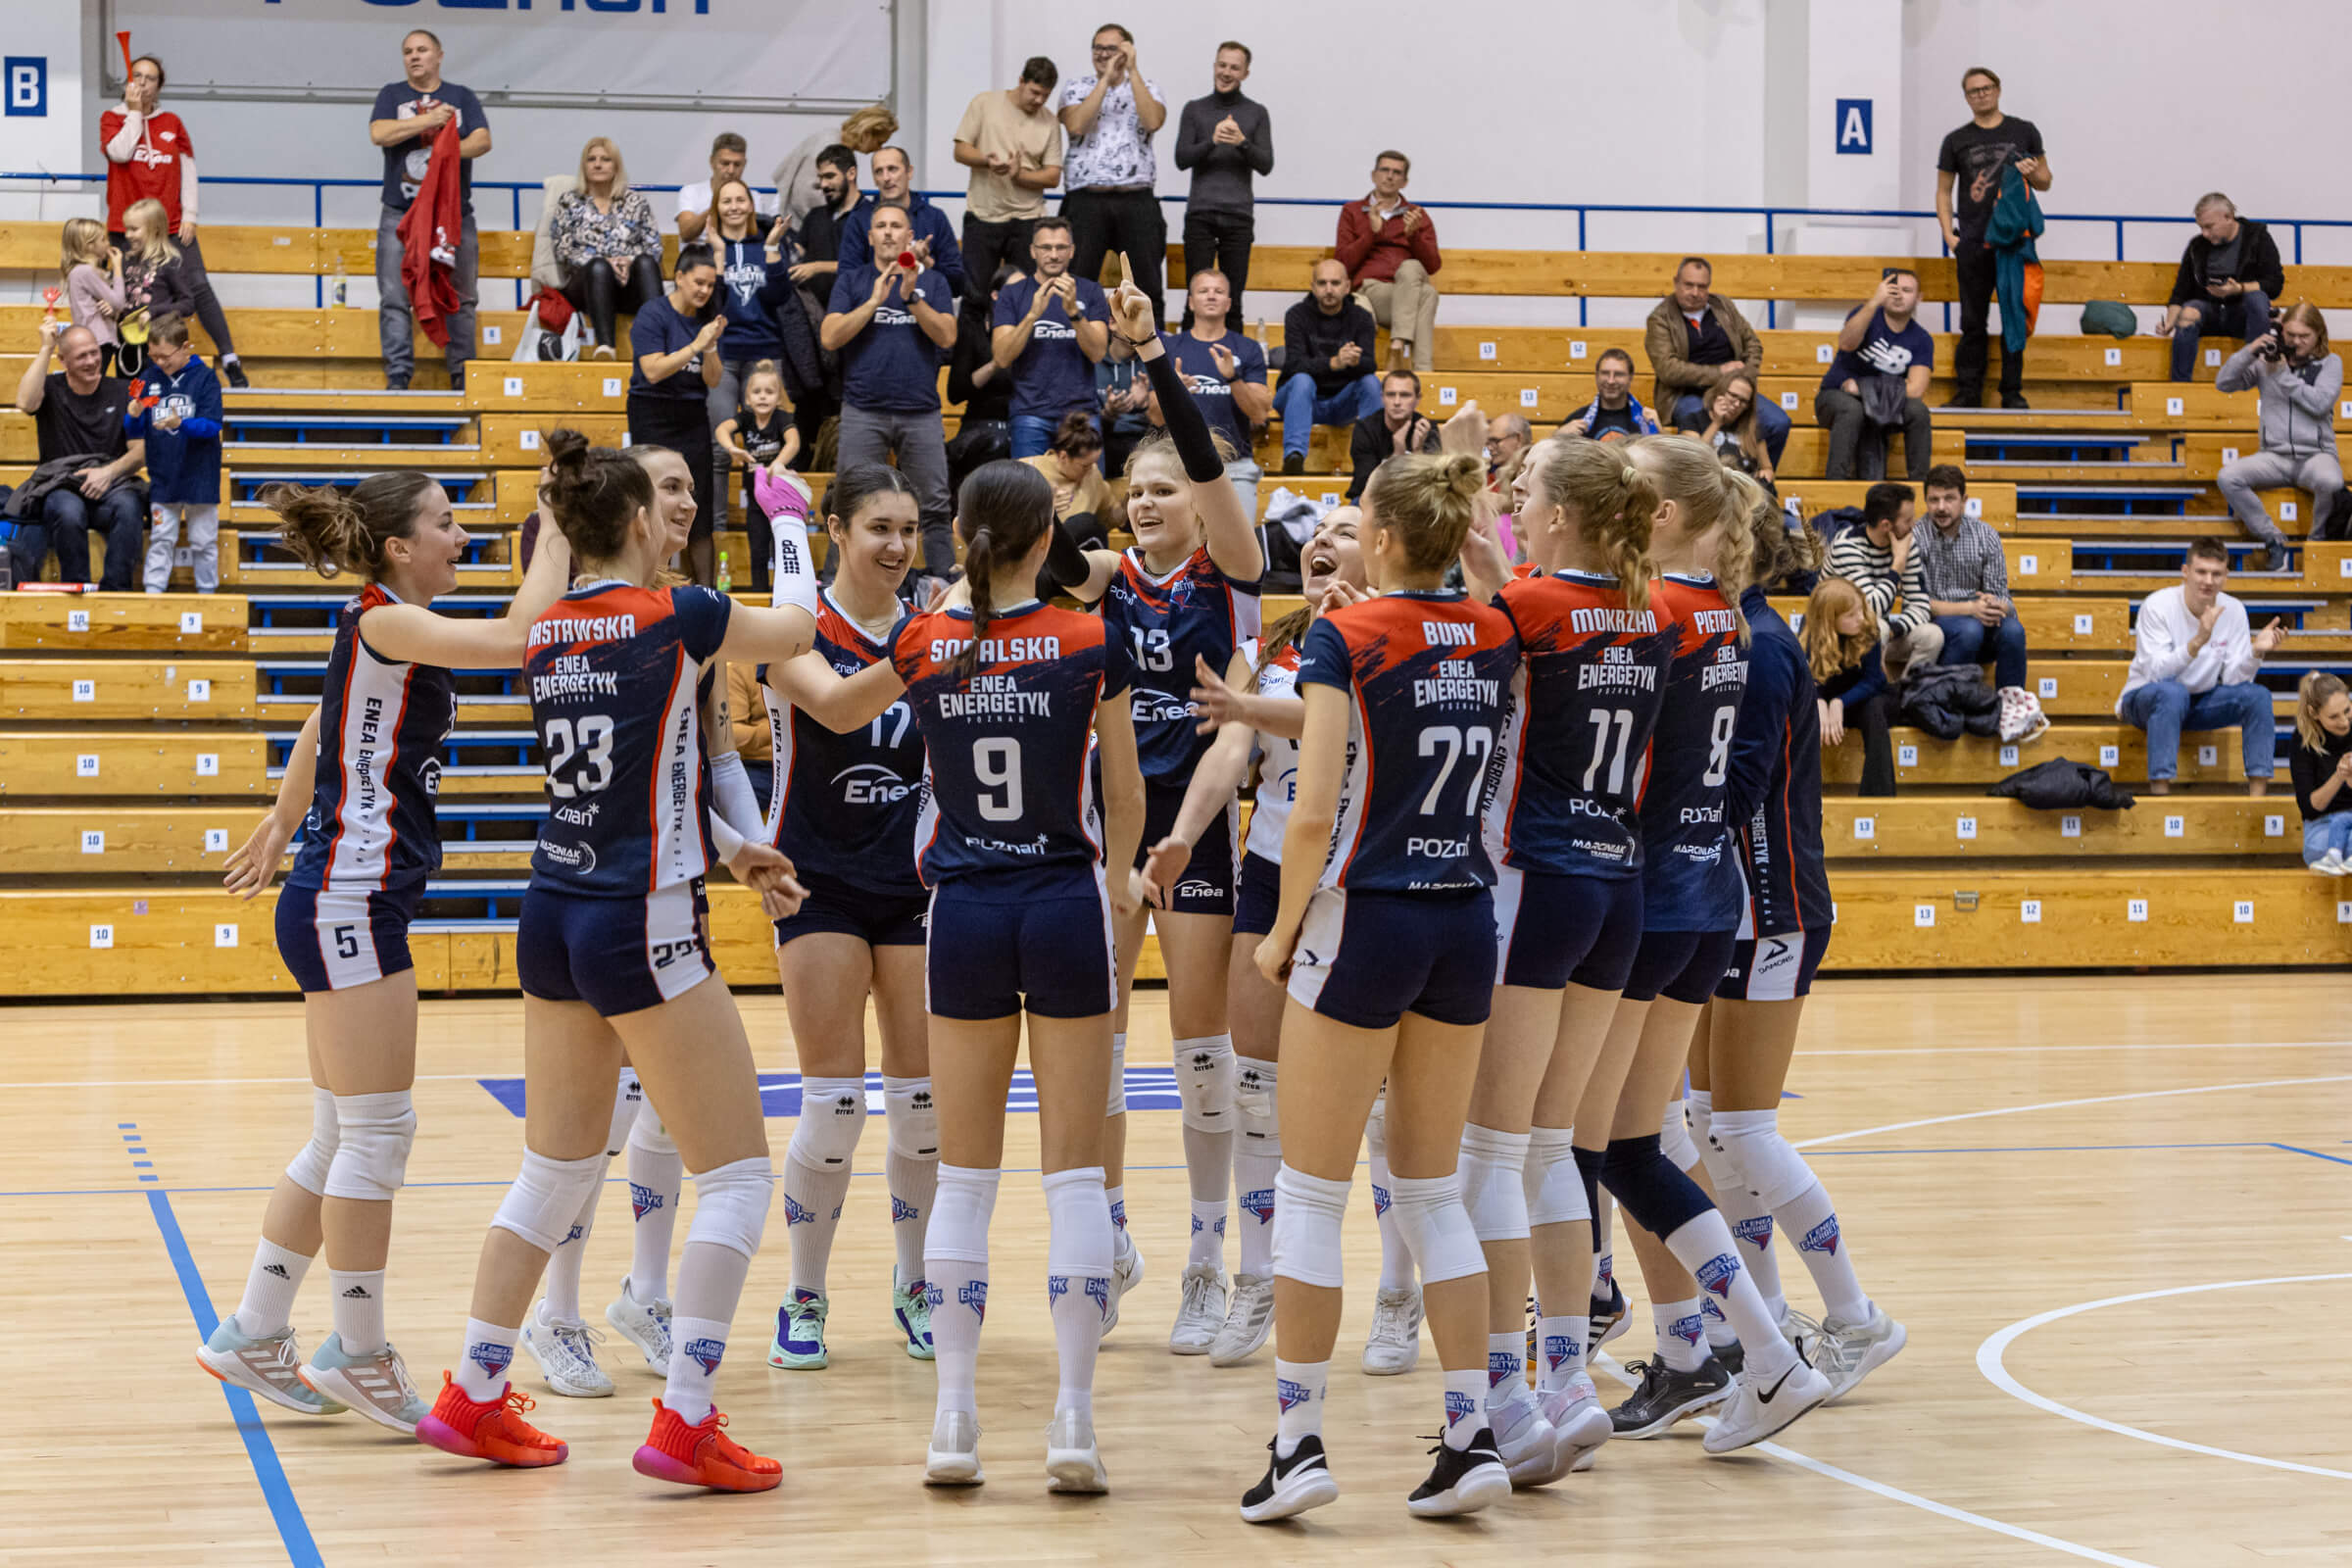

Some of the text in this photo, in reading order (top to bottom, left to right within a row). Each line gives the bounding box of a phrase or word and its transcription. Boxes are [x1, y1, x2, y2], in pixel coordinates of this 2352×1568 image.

[12, 66, 40, 108] B
[1840, 107, 1868, 146] A
[1033, 325, 1077, 339] Enea
[1130, 624, 1174, 673] 13
[1422, 620, 1478, 646] BURY
[554, 655, 591, 675] ENEA
[1438, 660, 1477, 679] ENEA
[1602, 646, 1636, 665] ENEA
[1716, 645, 1738, 663] ENEA
[532, 670, 618, 705] ENERGETYK
[969, 675, 1018, 693] ENEA
[1413, 679, 1500, 709] ENERGETYK
[1577, 663, 1657, 693] ENERGETYK
[360, 696, 382, 744] ENEA
[938, 691, 1052, 719] ENERGETYK
[870, 700, 911, 749] 17
[544, 713, 615, 800] 23
[1583, 708, 1634, 795] 11
[1701, 705, 1737, 787] 8
[844, 779, 922, 805] Ene
[972, 736, 1024, 822] 9
[671, 760, 688, 833] ENERGETYK
[1180, 885, 1224, 898] Enea
[336, 924, 359, 959] 5
